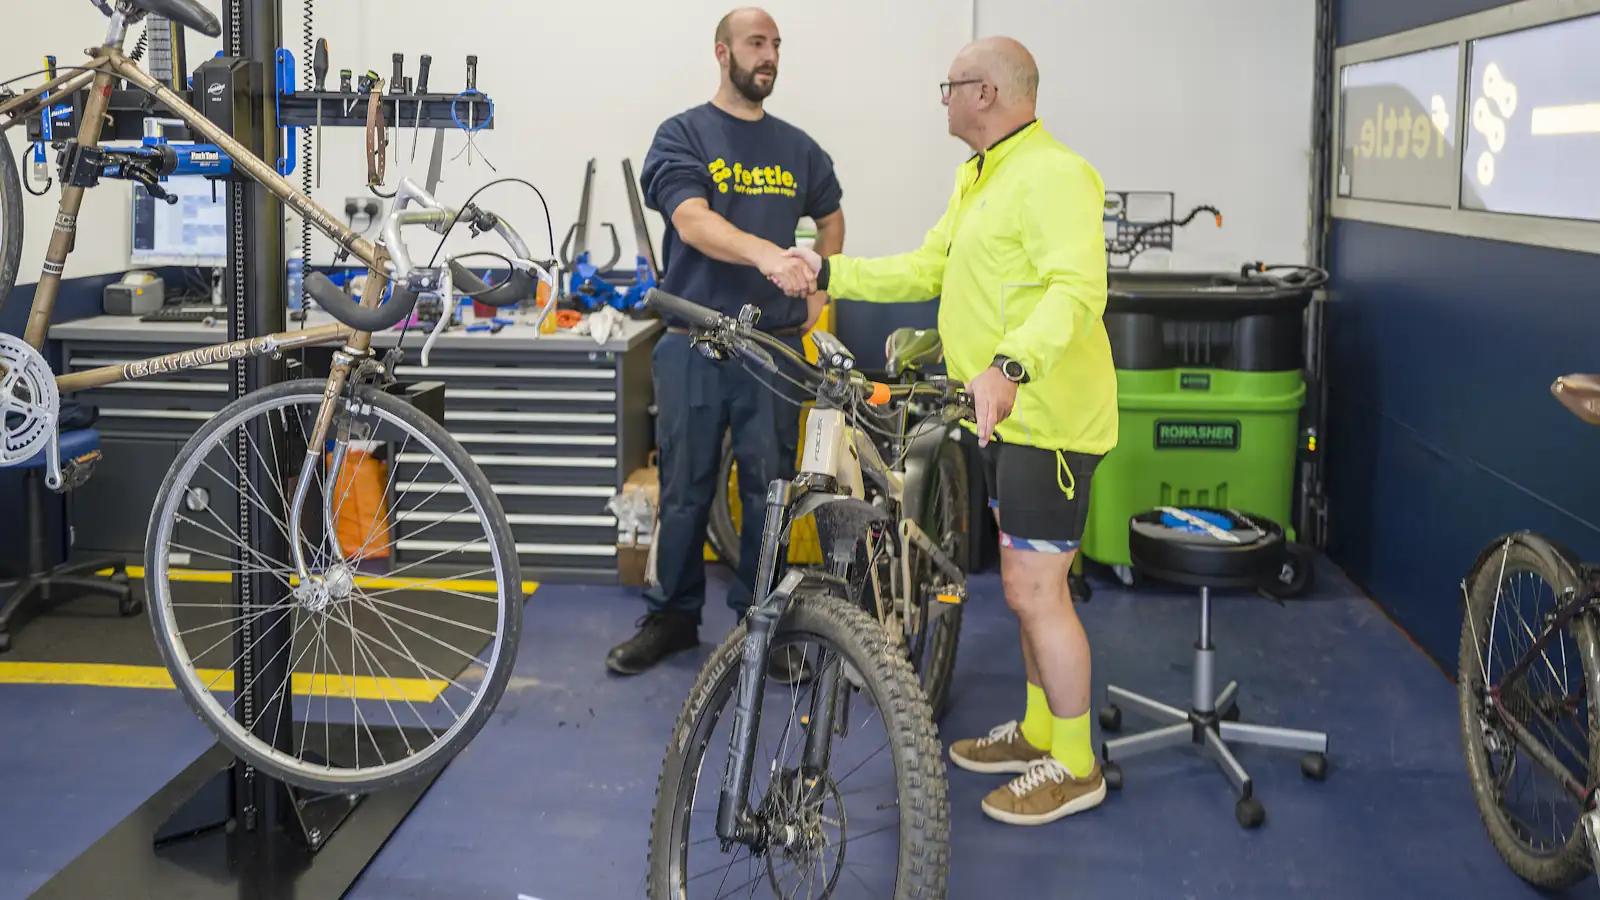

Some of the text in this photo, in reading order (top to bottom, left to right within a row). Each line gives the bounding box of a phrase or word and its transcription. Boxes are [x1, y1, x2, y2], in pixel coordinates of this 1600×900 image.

[732, 162, 797, 188] fettle.
[130, 341, 247, 378] BATAVUS
[815, 418, 823, 462] FOCUS
[1160, 425, 1234, 439] ROWASHER
[690, 661, 726, 723] MARY
